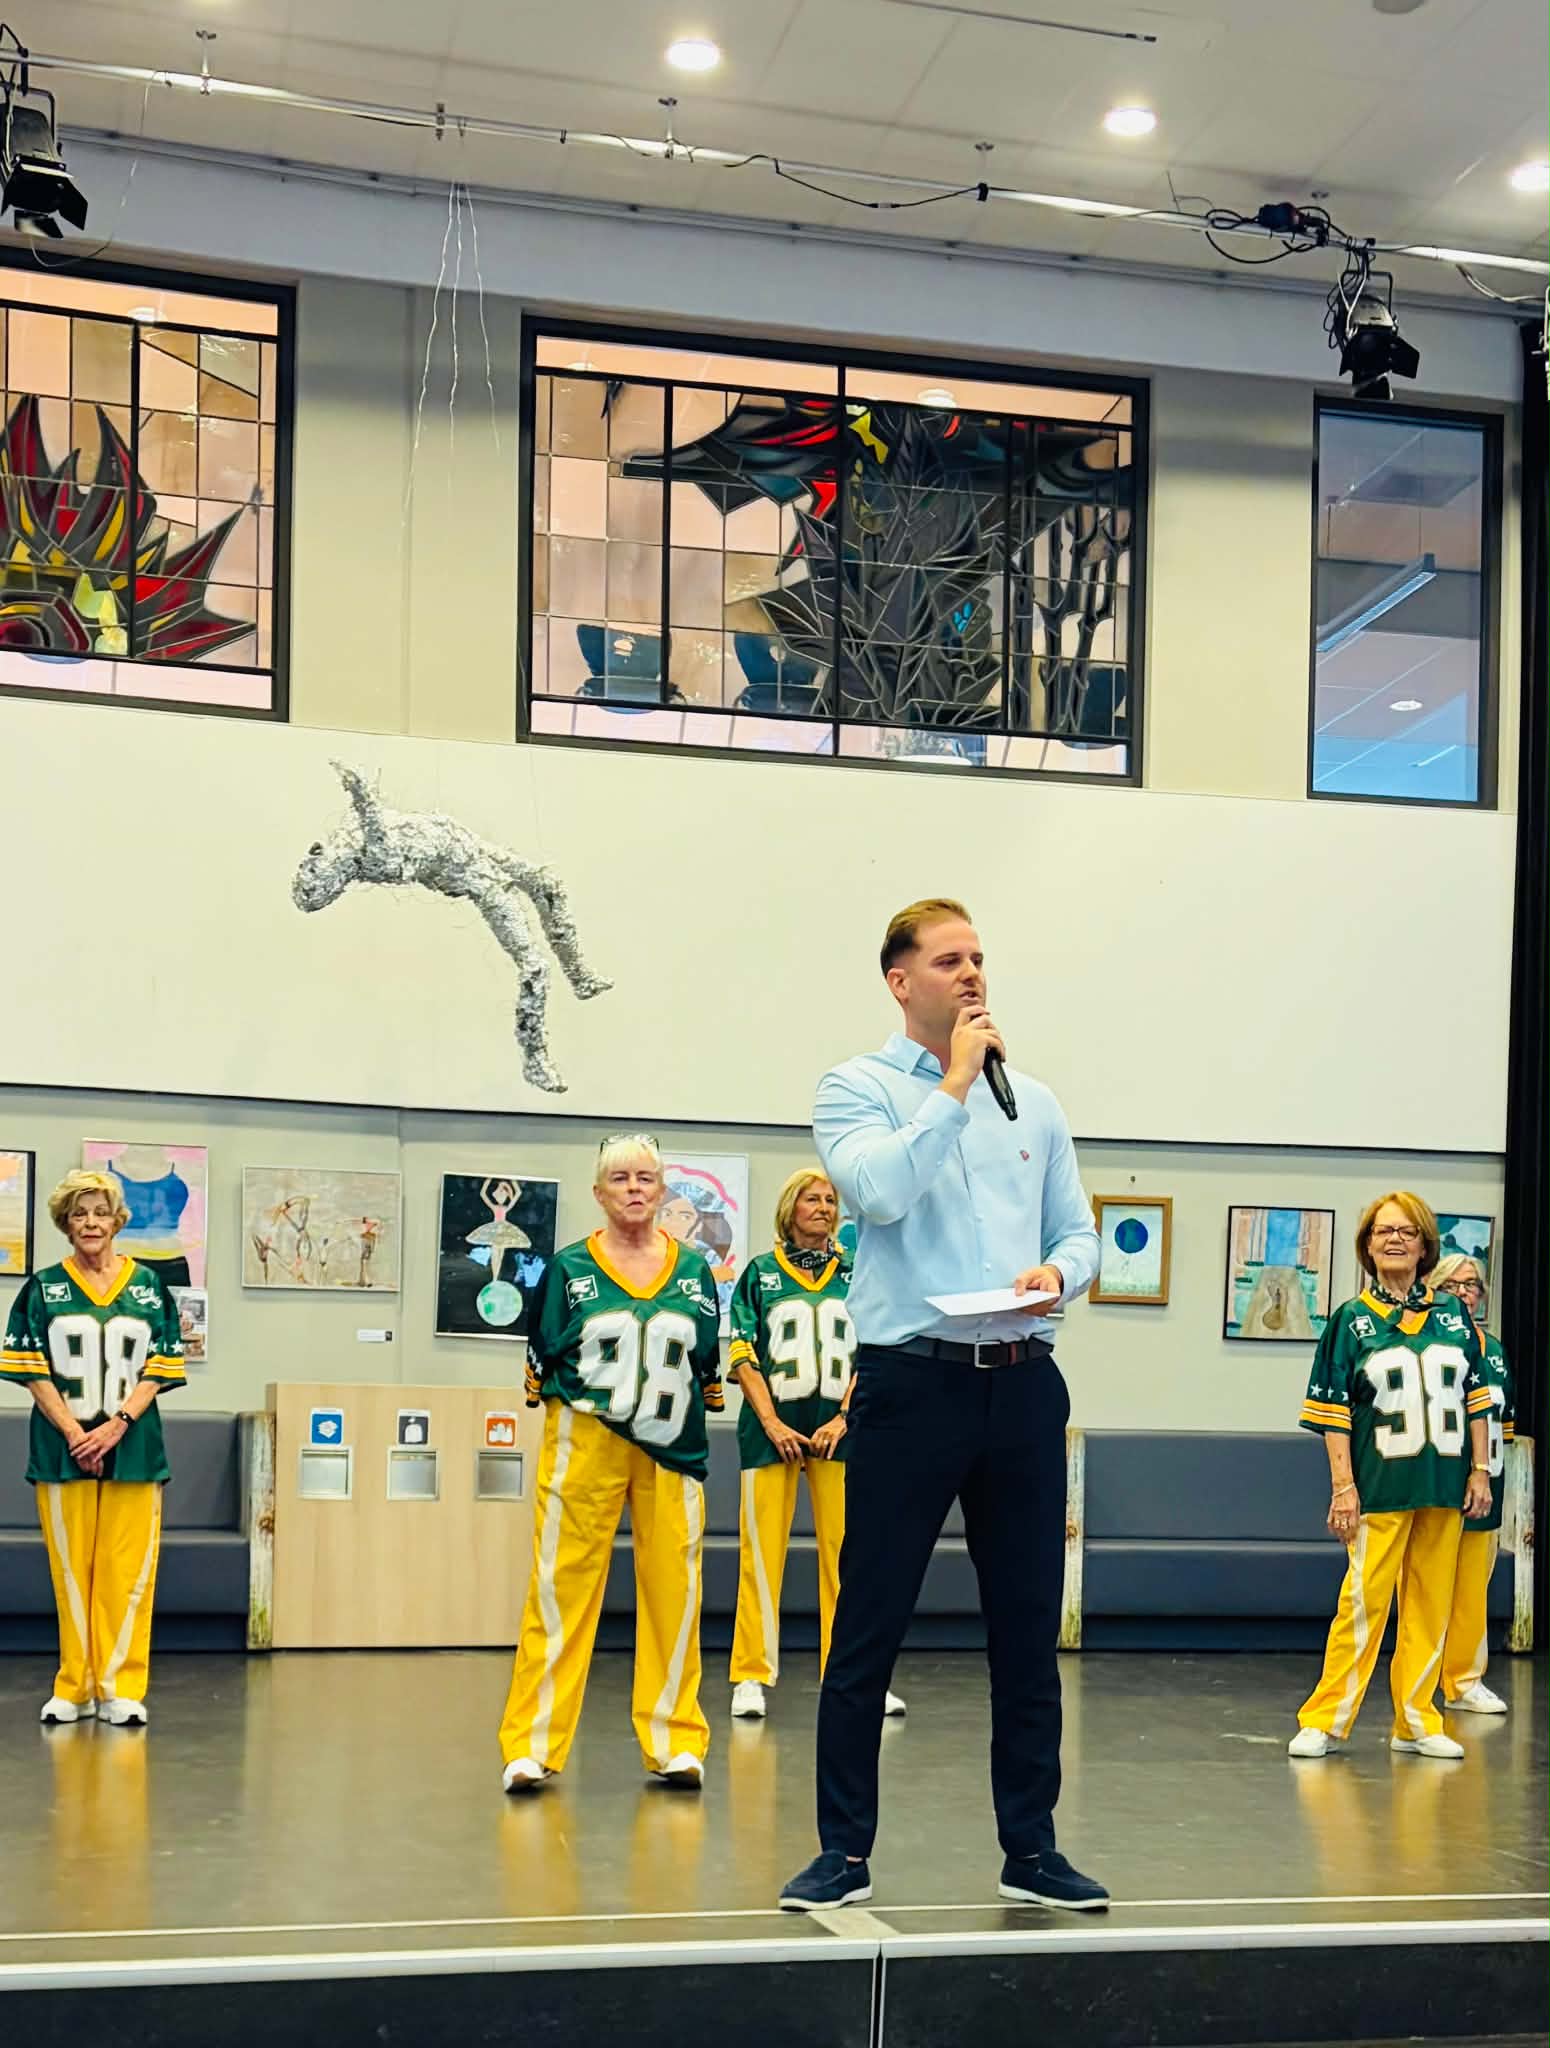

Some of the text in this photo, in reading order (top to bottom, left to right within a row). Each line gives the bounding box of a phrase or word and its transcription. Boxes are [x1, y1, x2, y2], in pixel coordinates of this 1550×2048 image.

[48, 1314, 152, 1420] 98
[572, 1310, 697, 1446] 98
[768, 1300, 857, 1402] 98
[1364, 1344, 1469, 1458] 98
